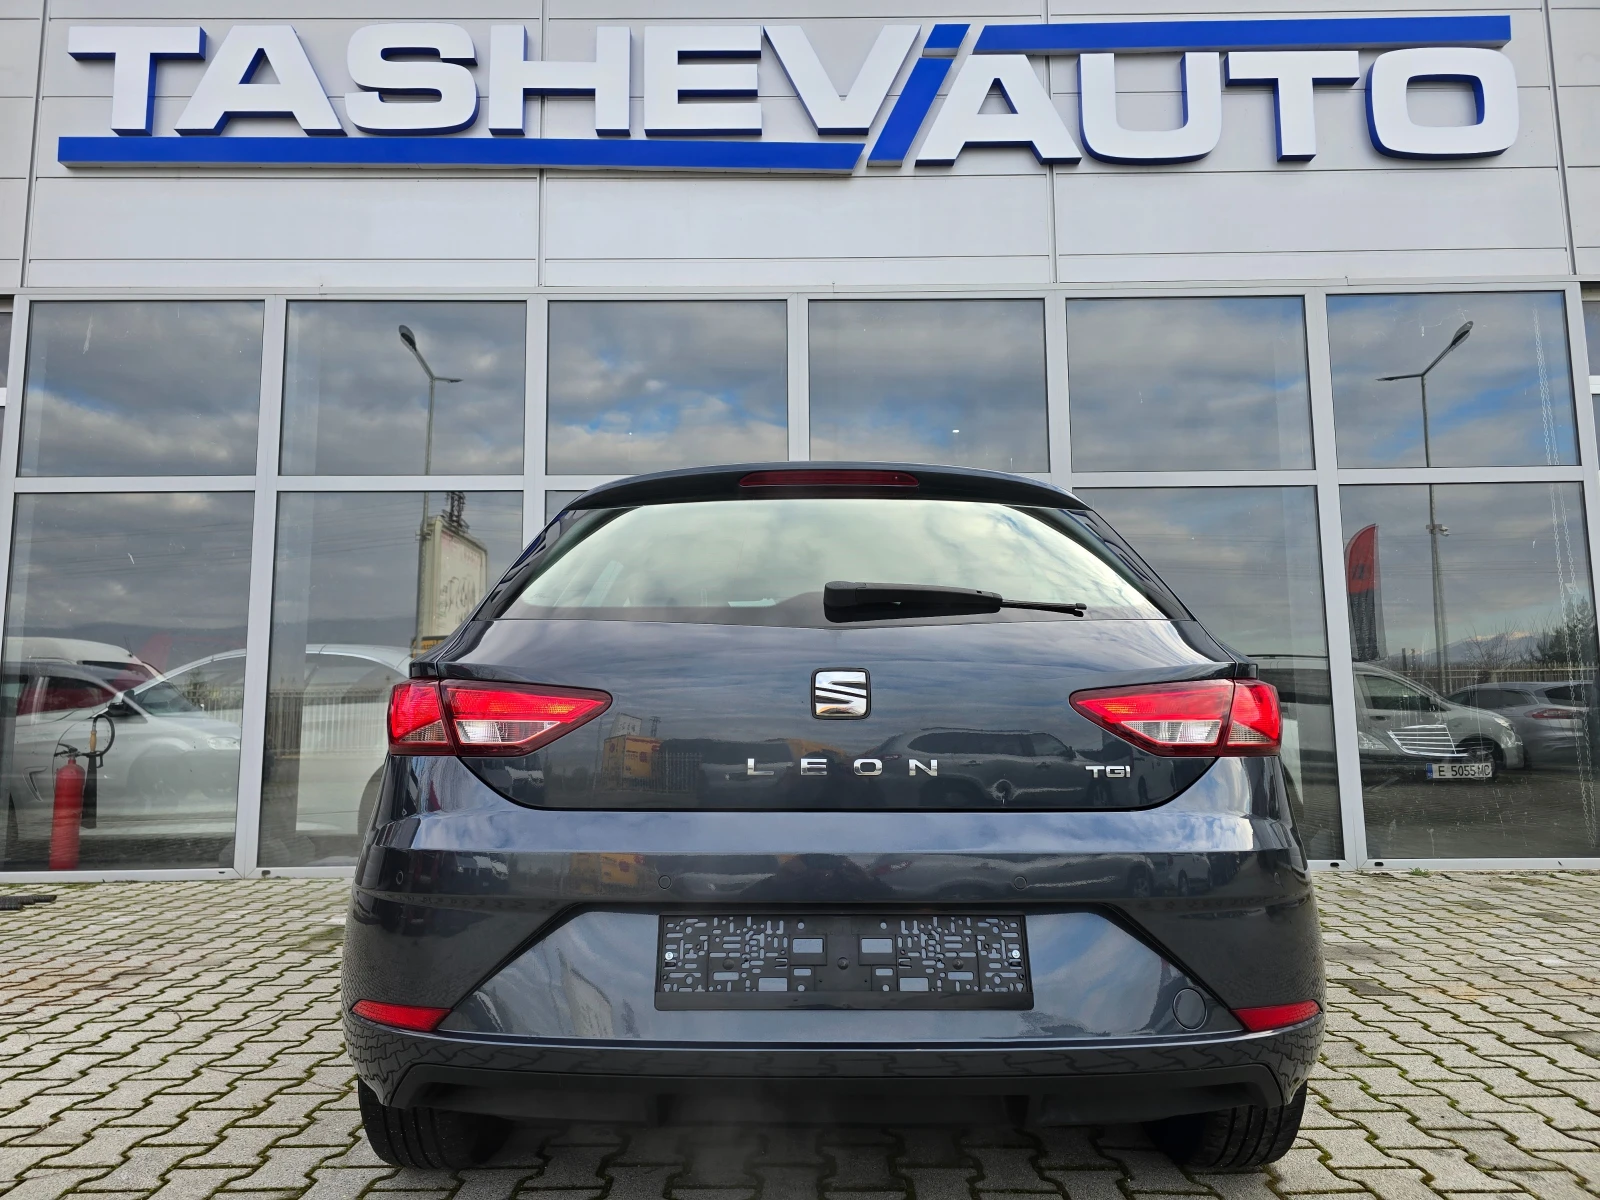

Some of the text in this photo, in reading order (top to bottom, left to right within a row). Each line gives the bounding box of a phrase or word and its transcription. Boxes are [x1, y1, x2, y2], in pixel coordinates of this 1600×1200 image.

[67, 23, 921, 137] TASHEV
[915, 47, 1519, 166] AUTO
[747, 758, 938, 777] LEON
[1085, 765, 1131, 778] TGI
[1438, 765, 1446, 777] E
[1450, 765, 1476, 777] 5055
